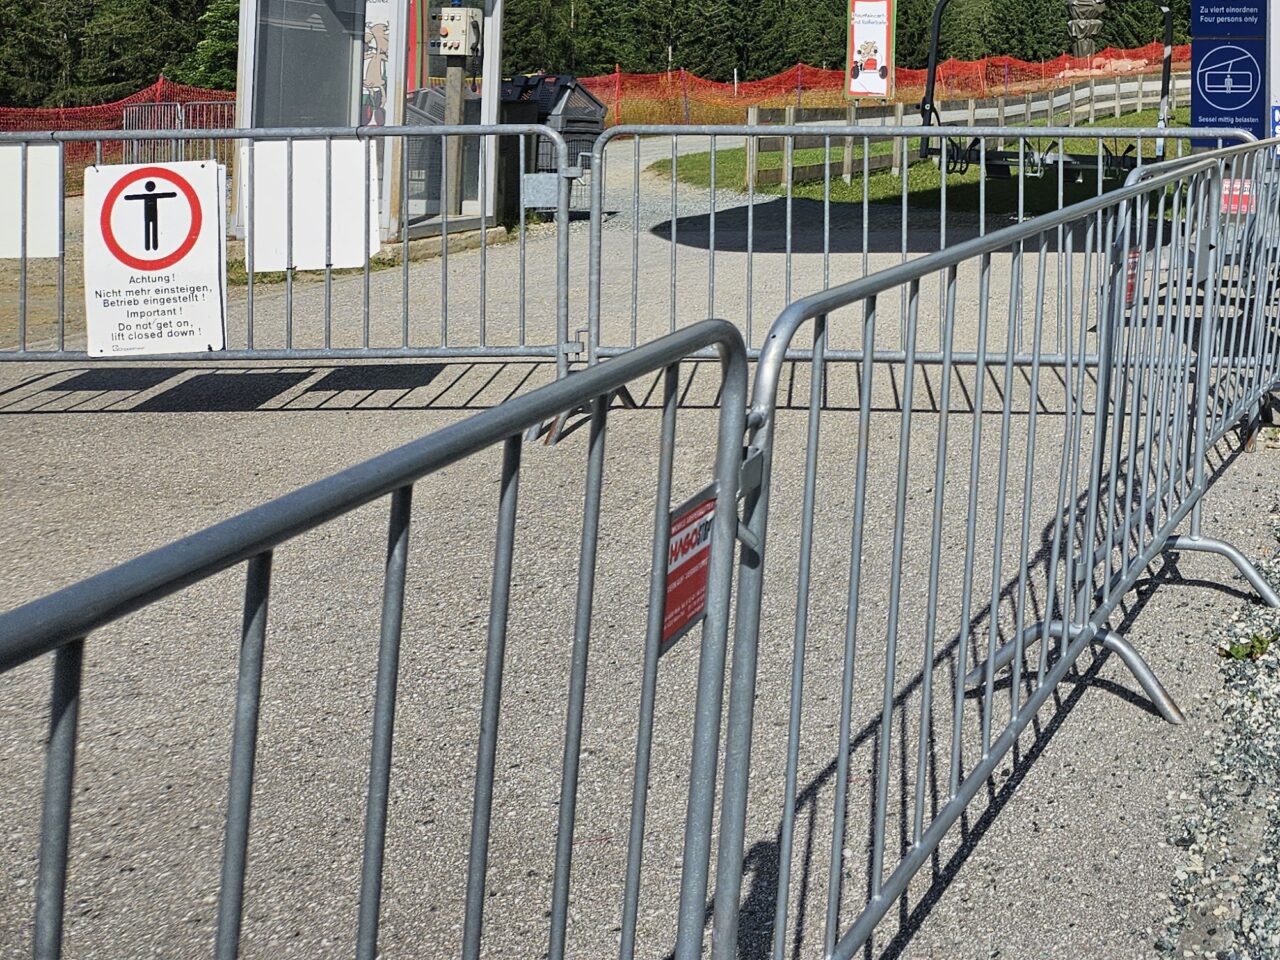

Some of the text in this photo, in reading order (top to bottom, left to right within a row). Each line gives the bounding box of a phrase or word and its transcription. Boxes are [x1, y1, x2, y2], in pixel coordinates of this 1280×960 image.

[1200, 6, 1259, 14] Zu viert einordnen
[1200, 15, 1258, 25] Four persons only
[1198, 115, 1259, 124] Sessel mittig belasten
[95, 284, 213, 299] Nicht mehr einsteigen,
[103, 298, 140, 308] Betrieb
[118, 320, 194, 332] Do not get on,
[111, 332, 125, 341] lift
[128, 329, 163, 341] closed
